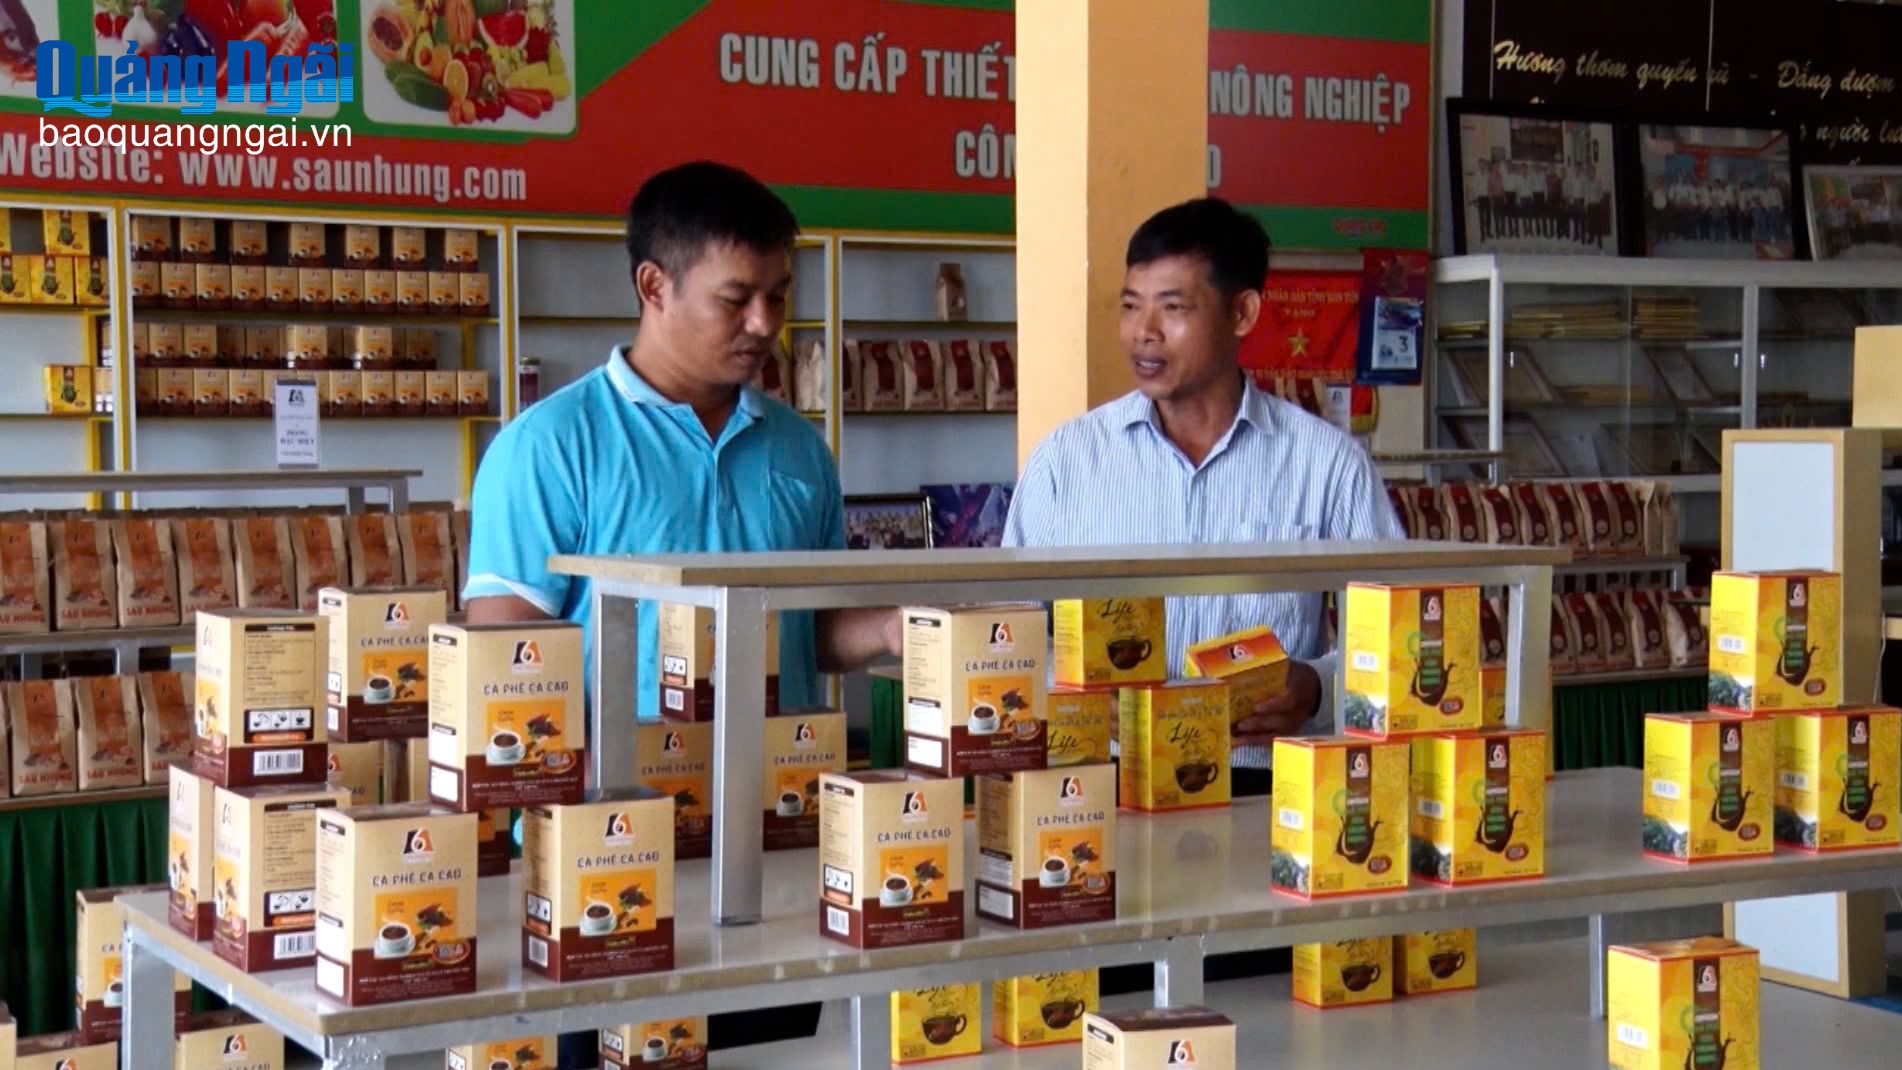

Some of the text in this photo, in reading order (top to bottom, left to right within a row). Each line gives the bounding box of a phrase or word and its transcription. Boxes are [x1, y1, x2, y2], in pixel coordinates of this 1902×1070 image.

[720, 32, 1016, 102] CUNG CẤP THIẾT
[1210, 63, 1410, 133] NÔNG NGHIỆP
[0, 132, 526, 202] Website: www.saunhung.com
[956, 123, 1016, 179] CÔN
